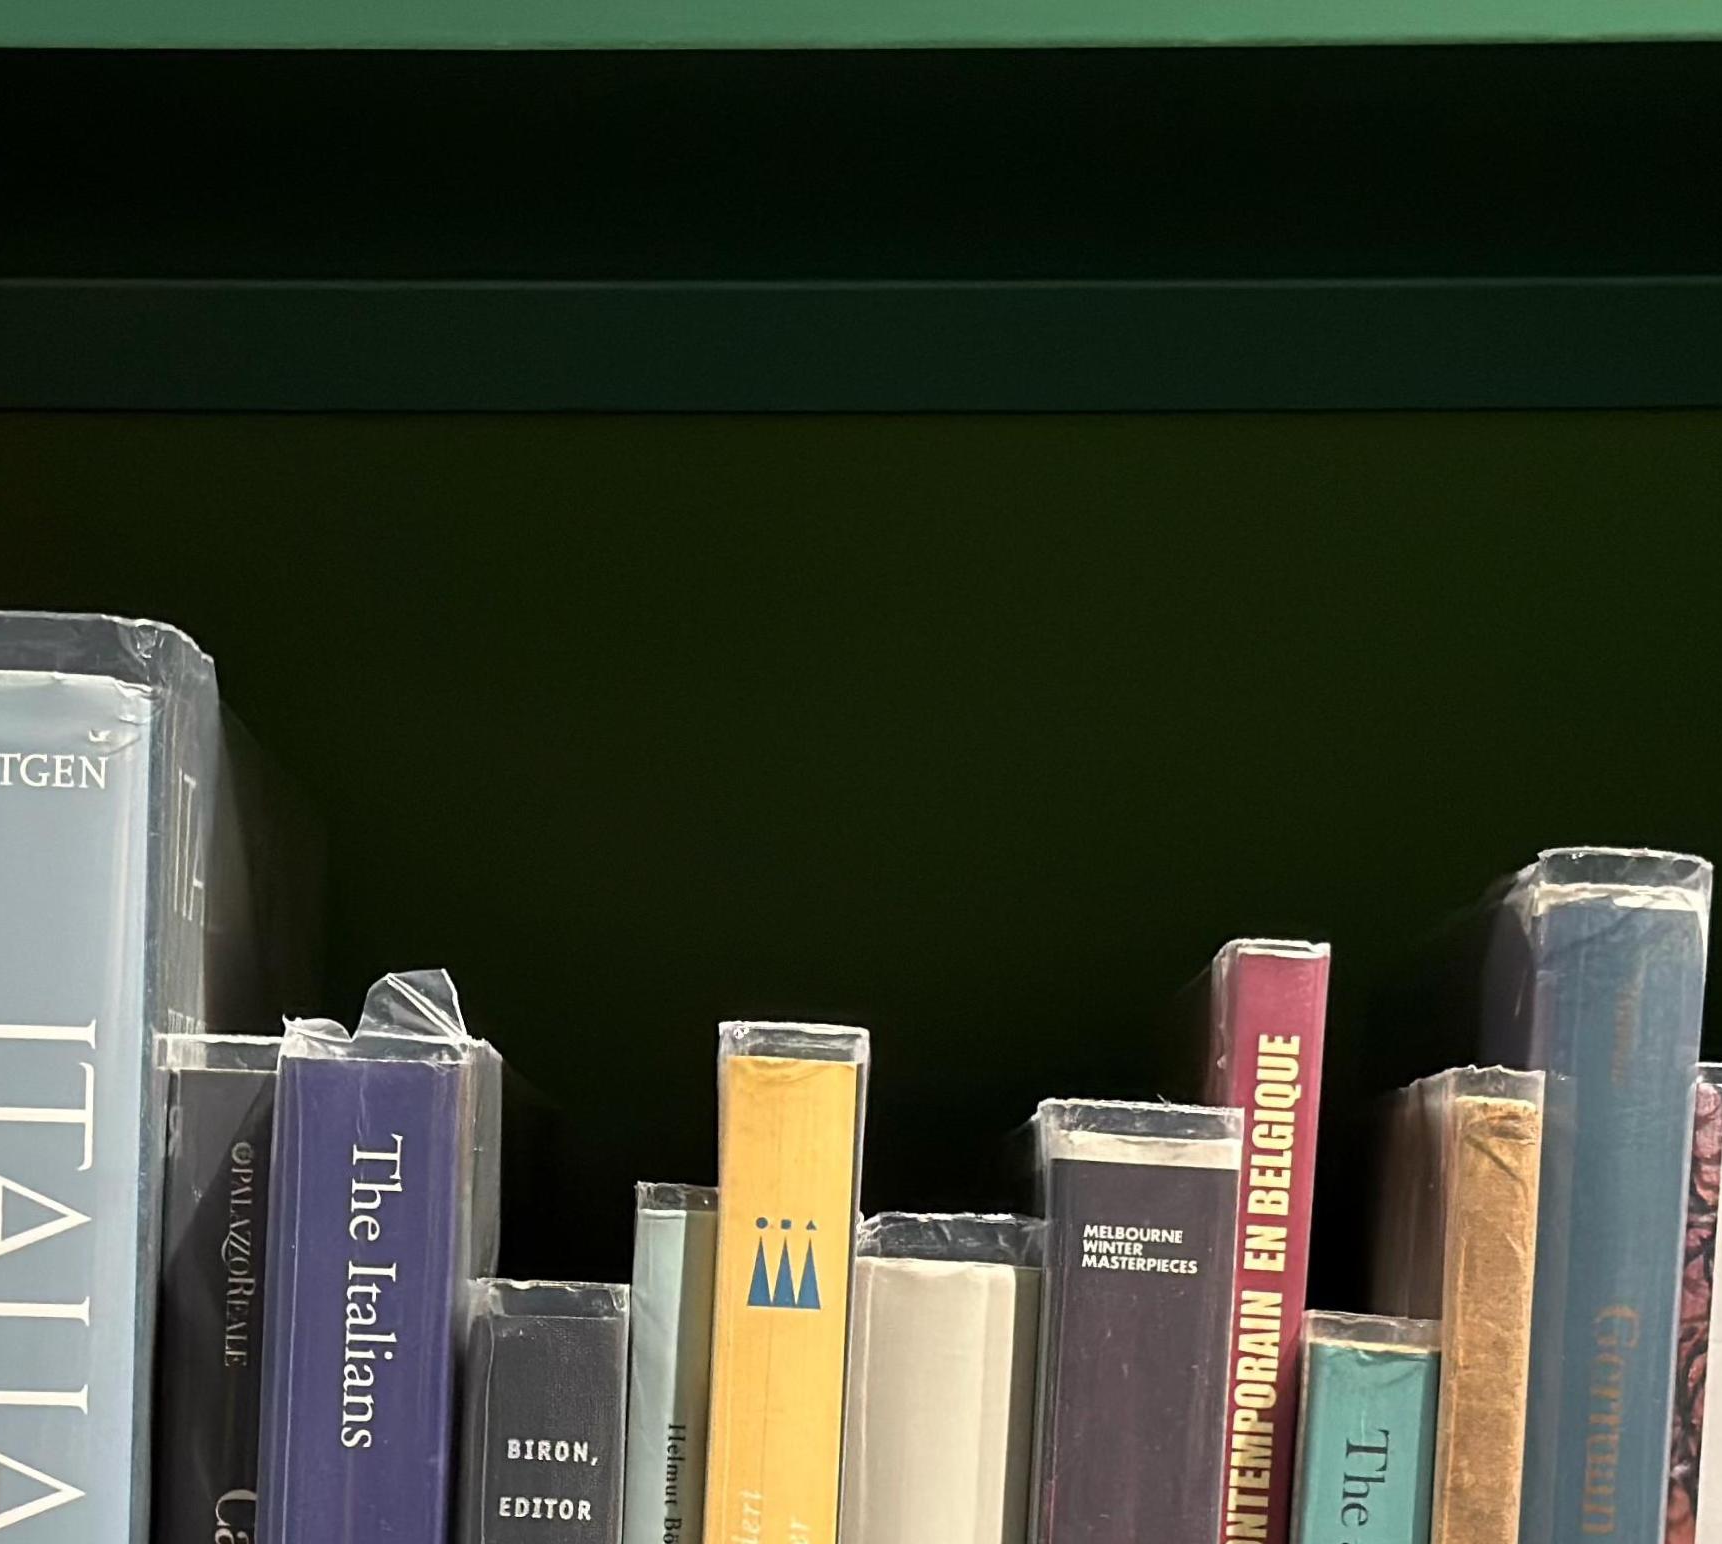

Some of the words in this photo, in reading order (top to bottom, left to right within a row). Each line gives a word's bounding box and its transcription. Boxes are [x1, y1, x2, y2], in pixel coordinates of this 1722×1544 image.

[1247, 1034, 1301, 1217] BELGIQUE
[350, 1135, 403, 1241] The
[1084, 1239, 1145, 1256] WINTER
[1085, 1226, 1184, 1247] MELBOURNE
[1244, 1228, 1286, 1273] EN
[1083, 1254, 1199, 1274] MASTERPIECES
[342, 1262, 397, 1448] Italians
[509, 1440, 598, 1467] BIRON,
[1343, 1431, 1390, 1527] The
[501, 1498, 592, 1521] EDITOR
